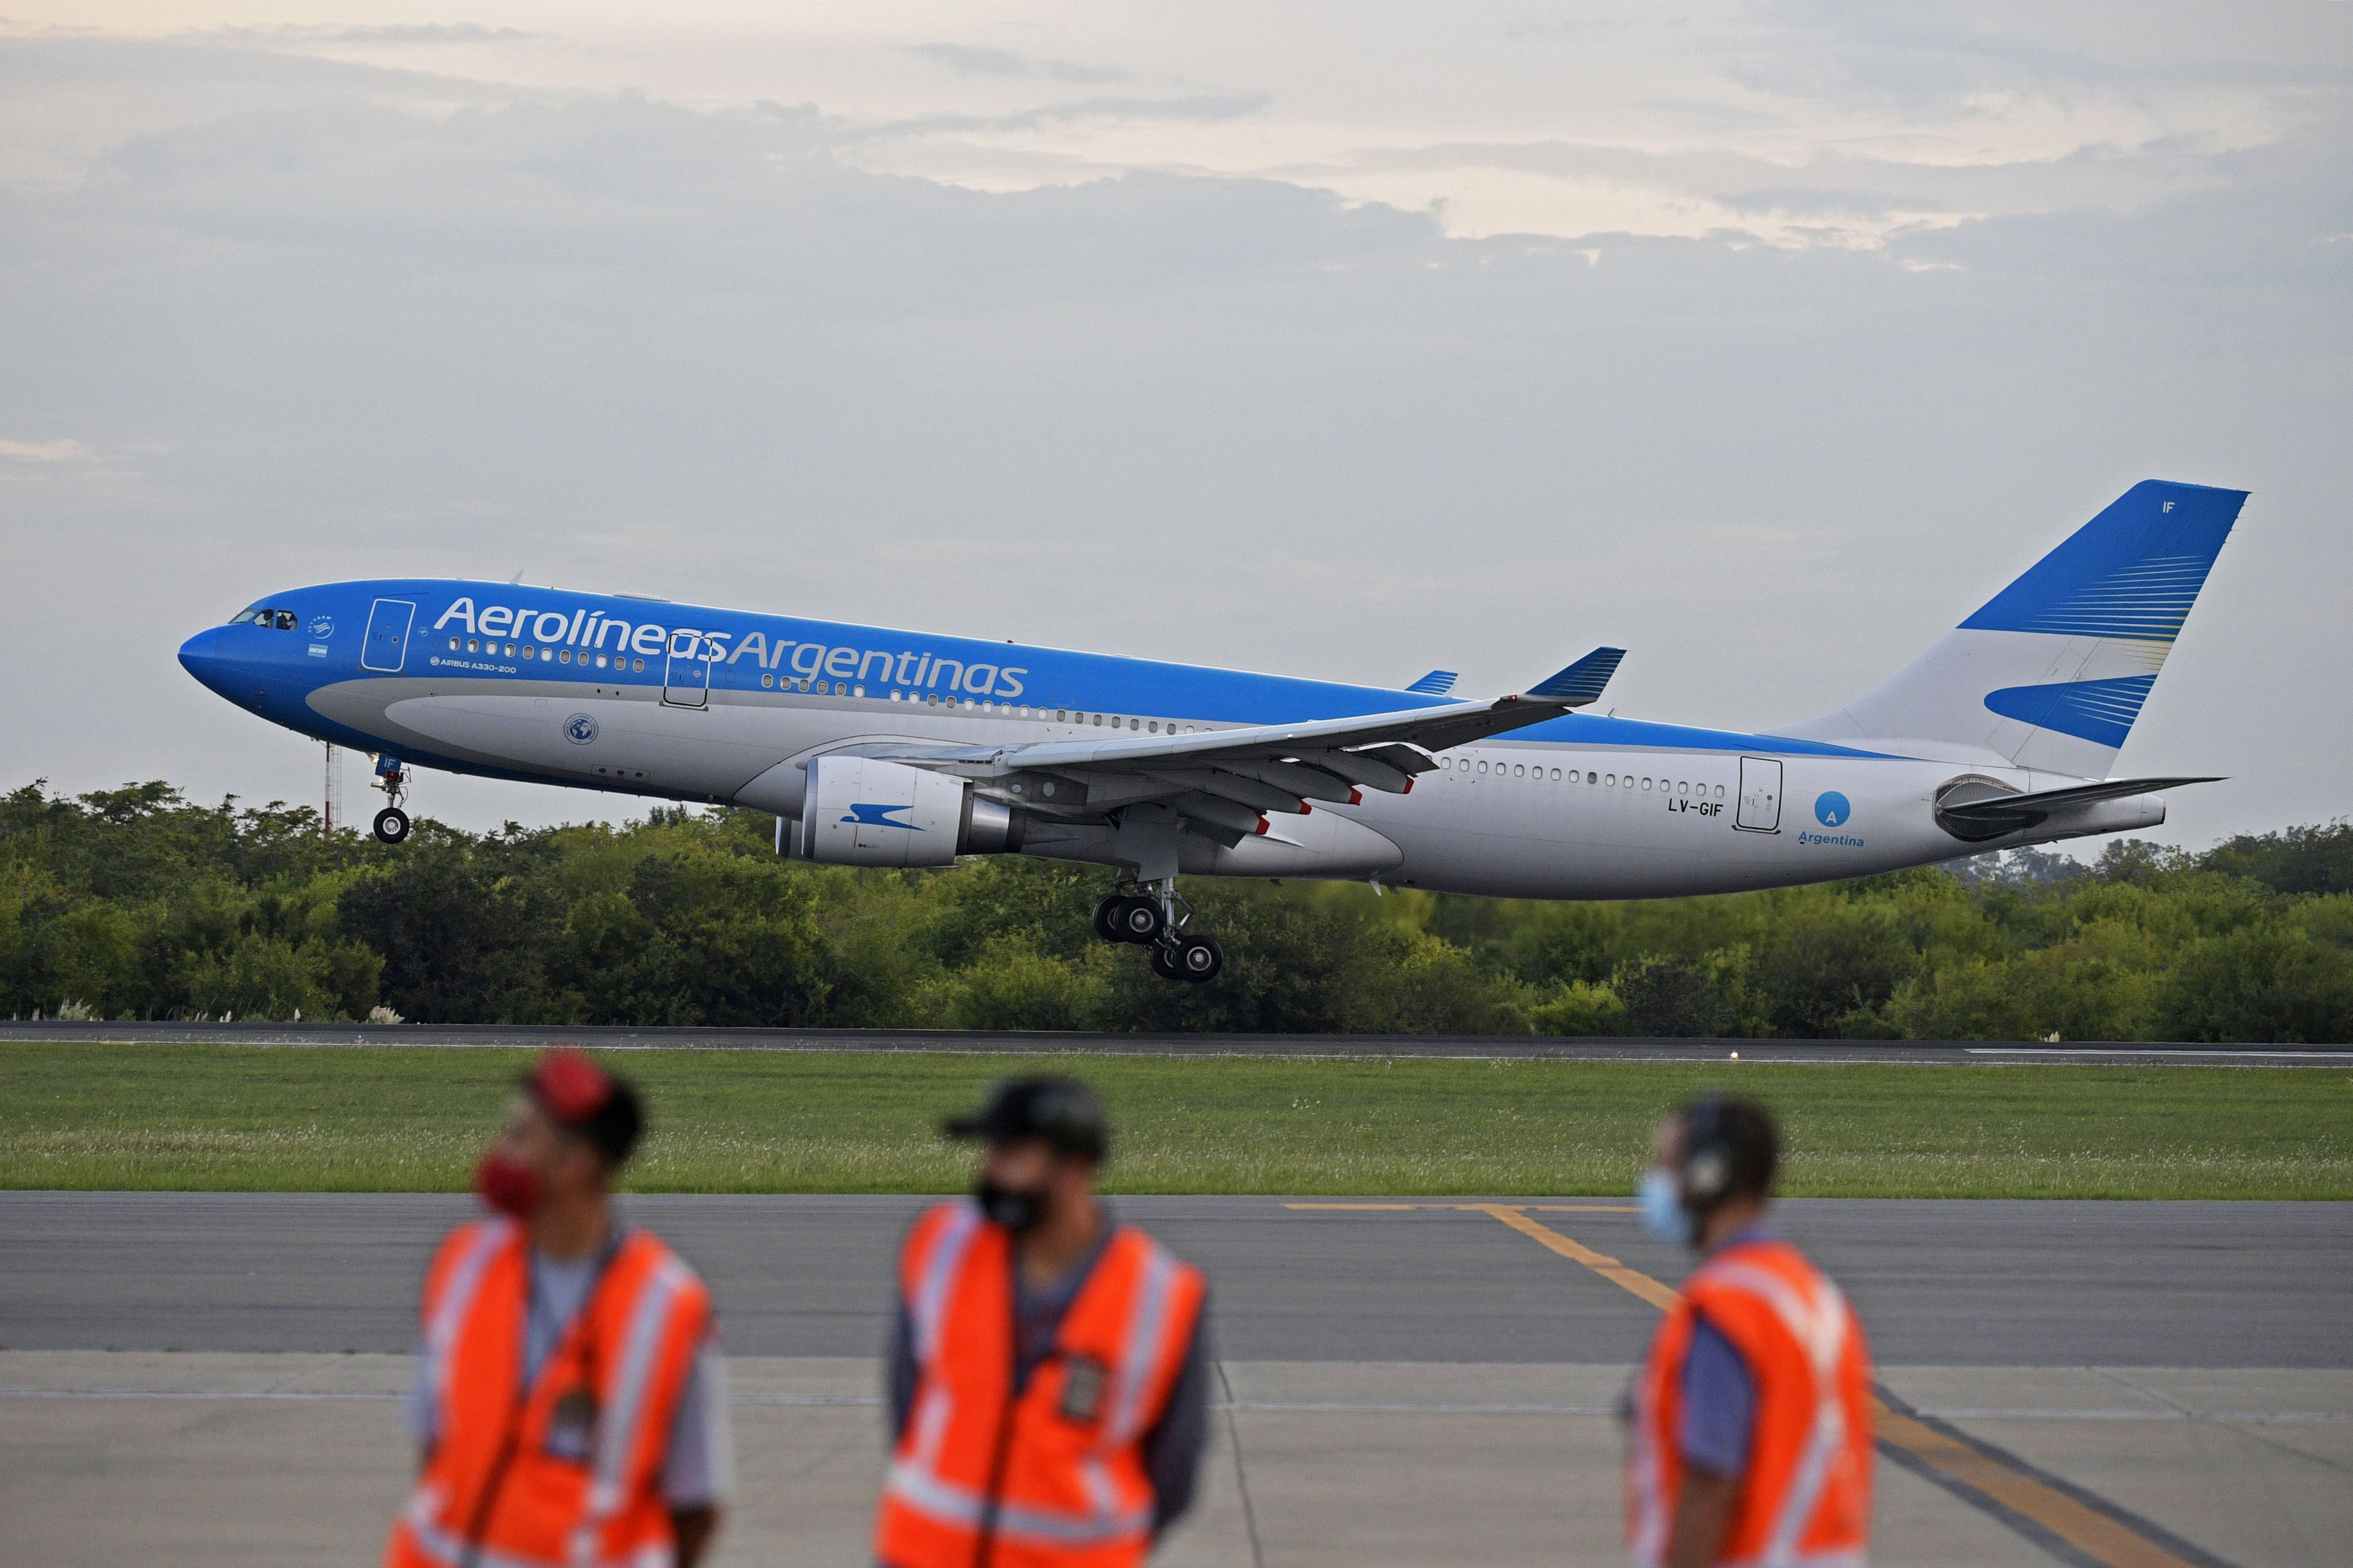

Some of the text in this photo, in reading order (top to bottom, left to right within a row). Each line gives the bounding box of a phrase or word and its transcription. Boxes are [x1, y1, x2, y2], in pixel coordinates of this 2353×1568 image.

[2163, 501, 2175, 513] IF
[434, 597, 1028, 697] Aerolíneas Argentinas
[440, 659, 516, 674] AIRBUS A330-200
[384, 758, 396, 768] IF
[1668, 798, 1723, 816] LV-GIF
[1798, 831, 1864, 847] Argentina
